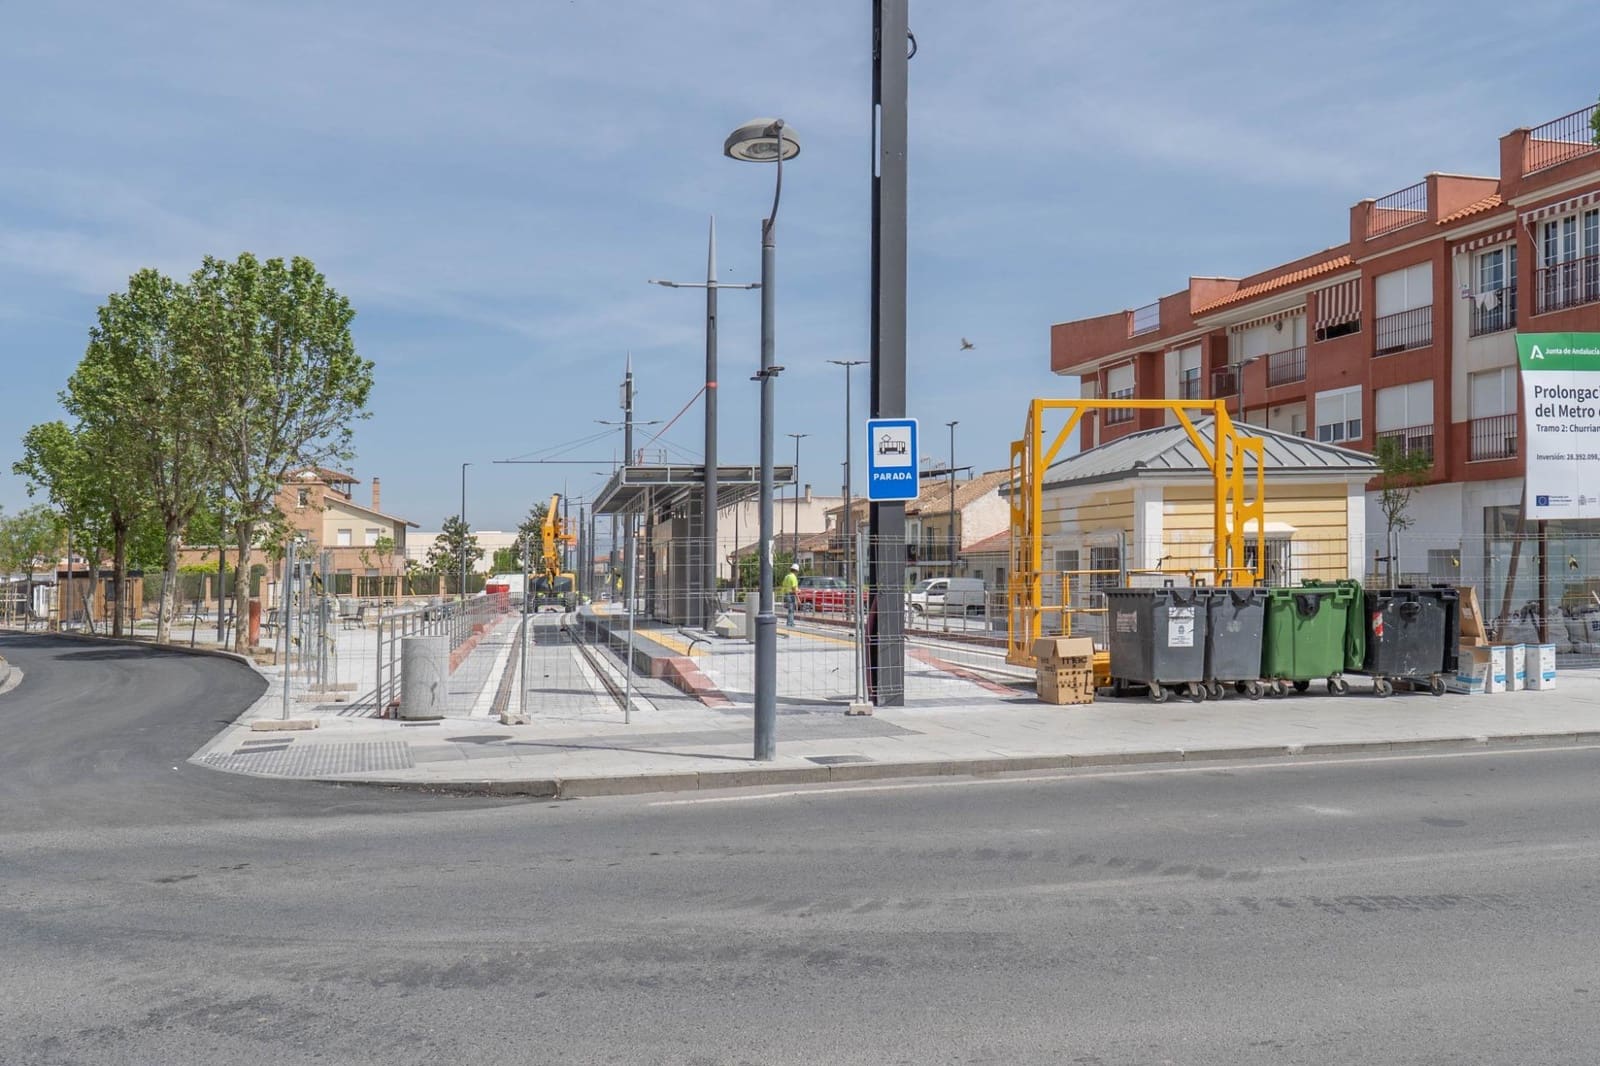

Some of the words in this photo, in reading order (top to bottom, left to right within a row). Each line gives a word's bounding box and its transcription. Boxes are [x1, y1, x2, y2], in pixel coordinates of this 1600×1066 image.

[1544, 347, 1562, 355] Junta
[1563, 347, 1570, 355] de
[1534, 384, 1600, 402] Prolongac
[1535, 403, 1555, 417] del
[1558, 404, 1595, 418] Metro
[1536, 424, 1560, 432] Tramo
[1561, 424, 1568, 432] 2:
[874, 471, 913, 480] PARADA
